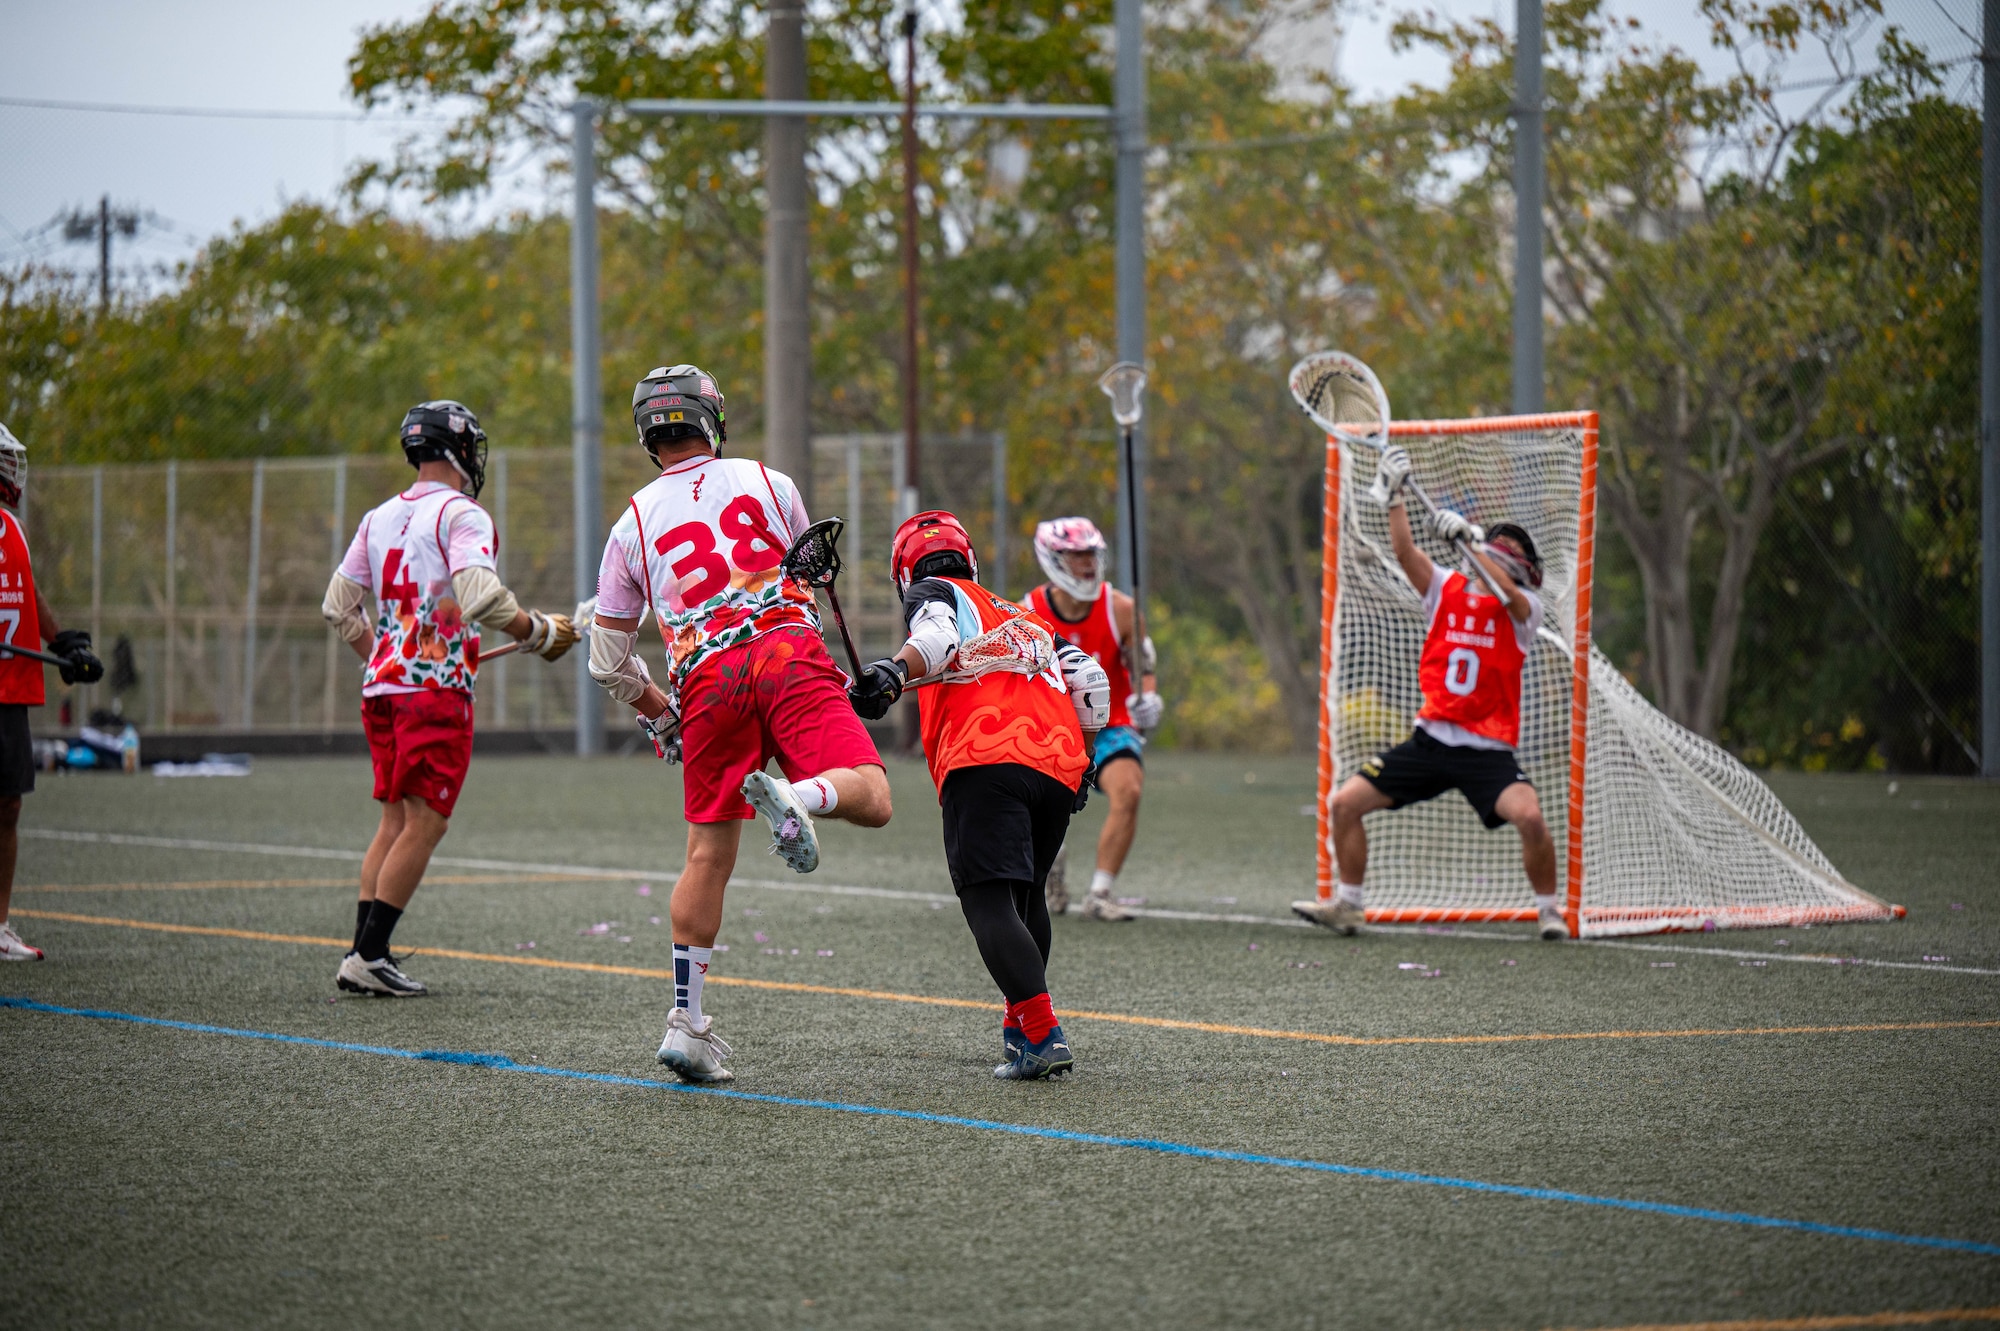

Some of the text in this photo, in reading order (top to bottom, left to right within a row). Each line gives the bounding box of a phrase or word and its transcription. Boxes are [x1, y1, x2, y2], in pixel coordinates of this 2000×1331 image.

[654, 494, 788, 608] 38
[381, 548, 419, 616] 4
[0, 608, 21, 660] 7
[1444, 646, 1481, 697] 0
